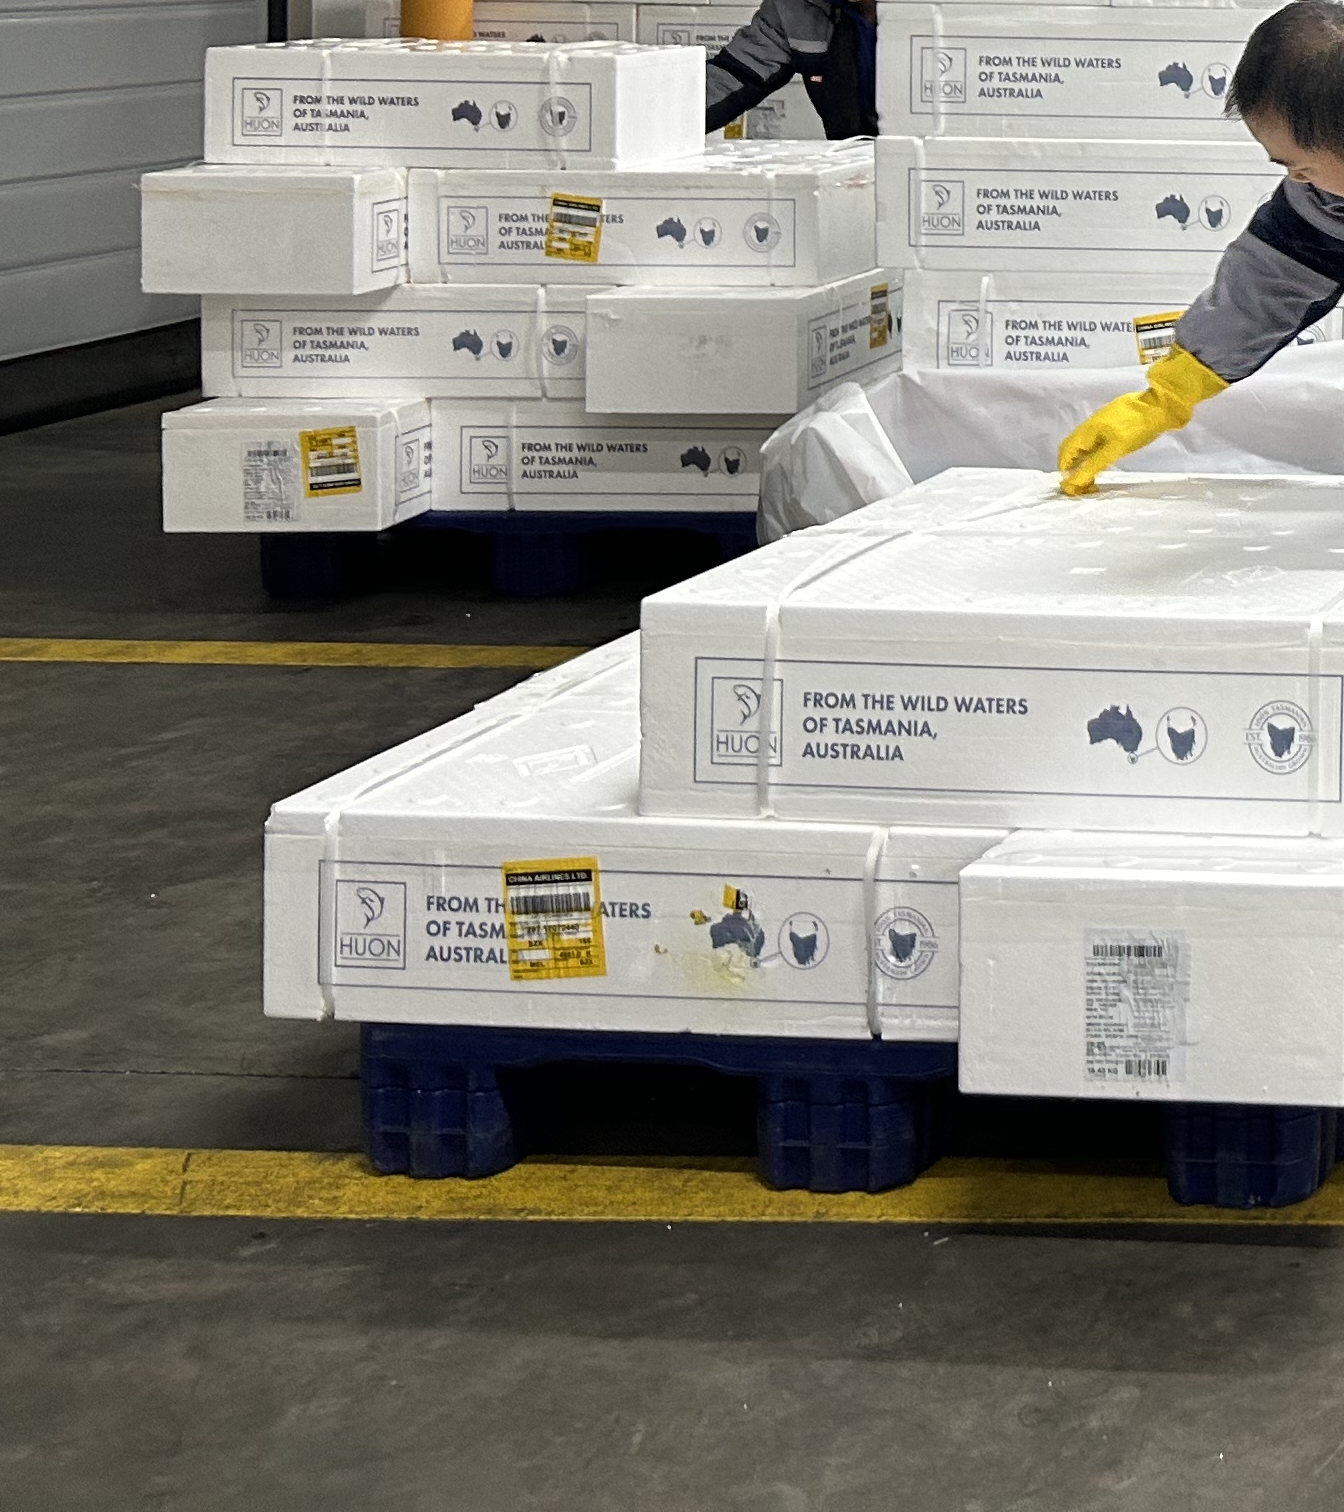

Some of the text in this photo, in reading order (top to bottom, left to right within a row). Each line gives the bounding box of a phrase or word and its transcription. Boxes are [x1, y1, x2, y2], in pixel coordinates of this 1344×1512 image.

[978, 55, 1122, 69] FROM THE WILD WATERS
[978, 71, 995, 82] OF
[924, 82, 962, 95] HON
[978, 87, 1043, 99] AUSTRALIA
[976, 188, 1119, 201] FROM THE WILD WATERS
[976, 203, 992, 215] OF
[922, 215, 961, 228] HUON
[976, 219, 1041, 231] AUSTRALIA
[291, 326, 419, 336] FROM THE WILD WATERS
[291, 340, 306, 350] OF
[243, 350, 278, 361] HUON
[291, 353, 349, 363] AUSTRALIA
[520, 443, 648, 454] FROM THE WILD WATERS
[520, 456, 535, 466] OF
[520, 470, 578, 480] AUSTRALIA
[802, 691, 1029, 715] FROM THE WILD WATERS
[803, 716, 938, 741] OF TASMANIA,
[802, 742, 904, 762] AUSTRALIA
[426, 894, 652, 920] FROM TH ATERS
[426, 920, 451, 938] OF
[340, 936, 400, 957] HUON
[425, 945, 508, 966] AUSTRAL
